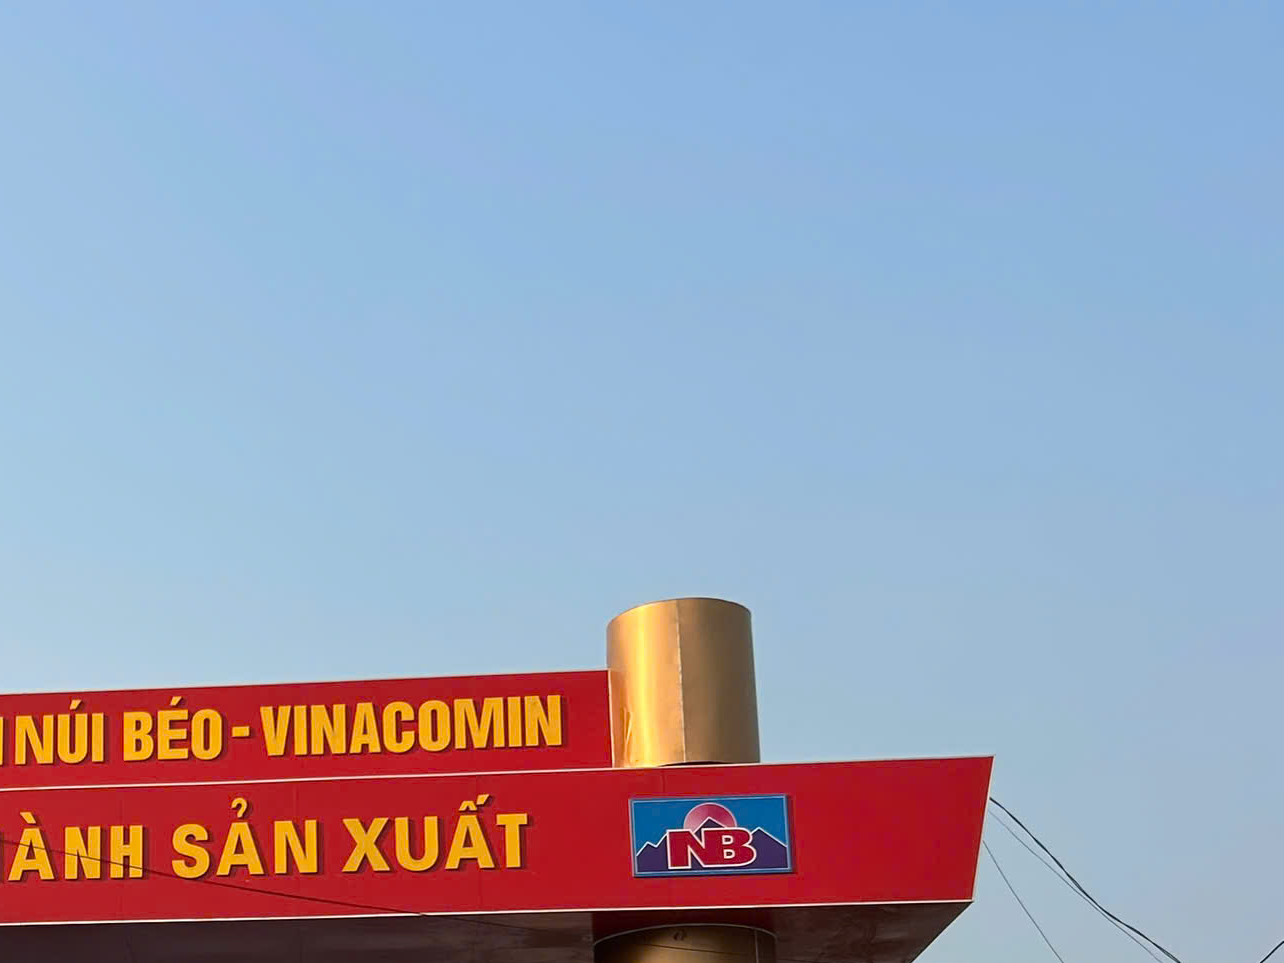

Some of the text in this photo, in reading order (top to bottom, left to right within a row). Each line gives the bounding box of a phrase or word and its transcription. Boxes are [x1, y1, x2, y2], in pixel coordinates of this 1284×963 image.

[15, 701, 105, 765] NÚI
[124, 697, 223, 761] BÉO
[260, 695, 563, 757] VINACOMIN
[172, 797, 318, 879] SẢN
[342, 794, 529, 873] XUẤT
[667, 827, 757, 869] NB
